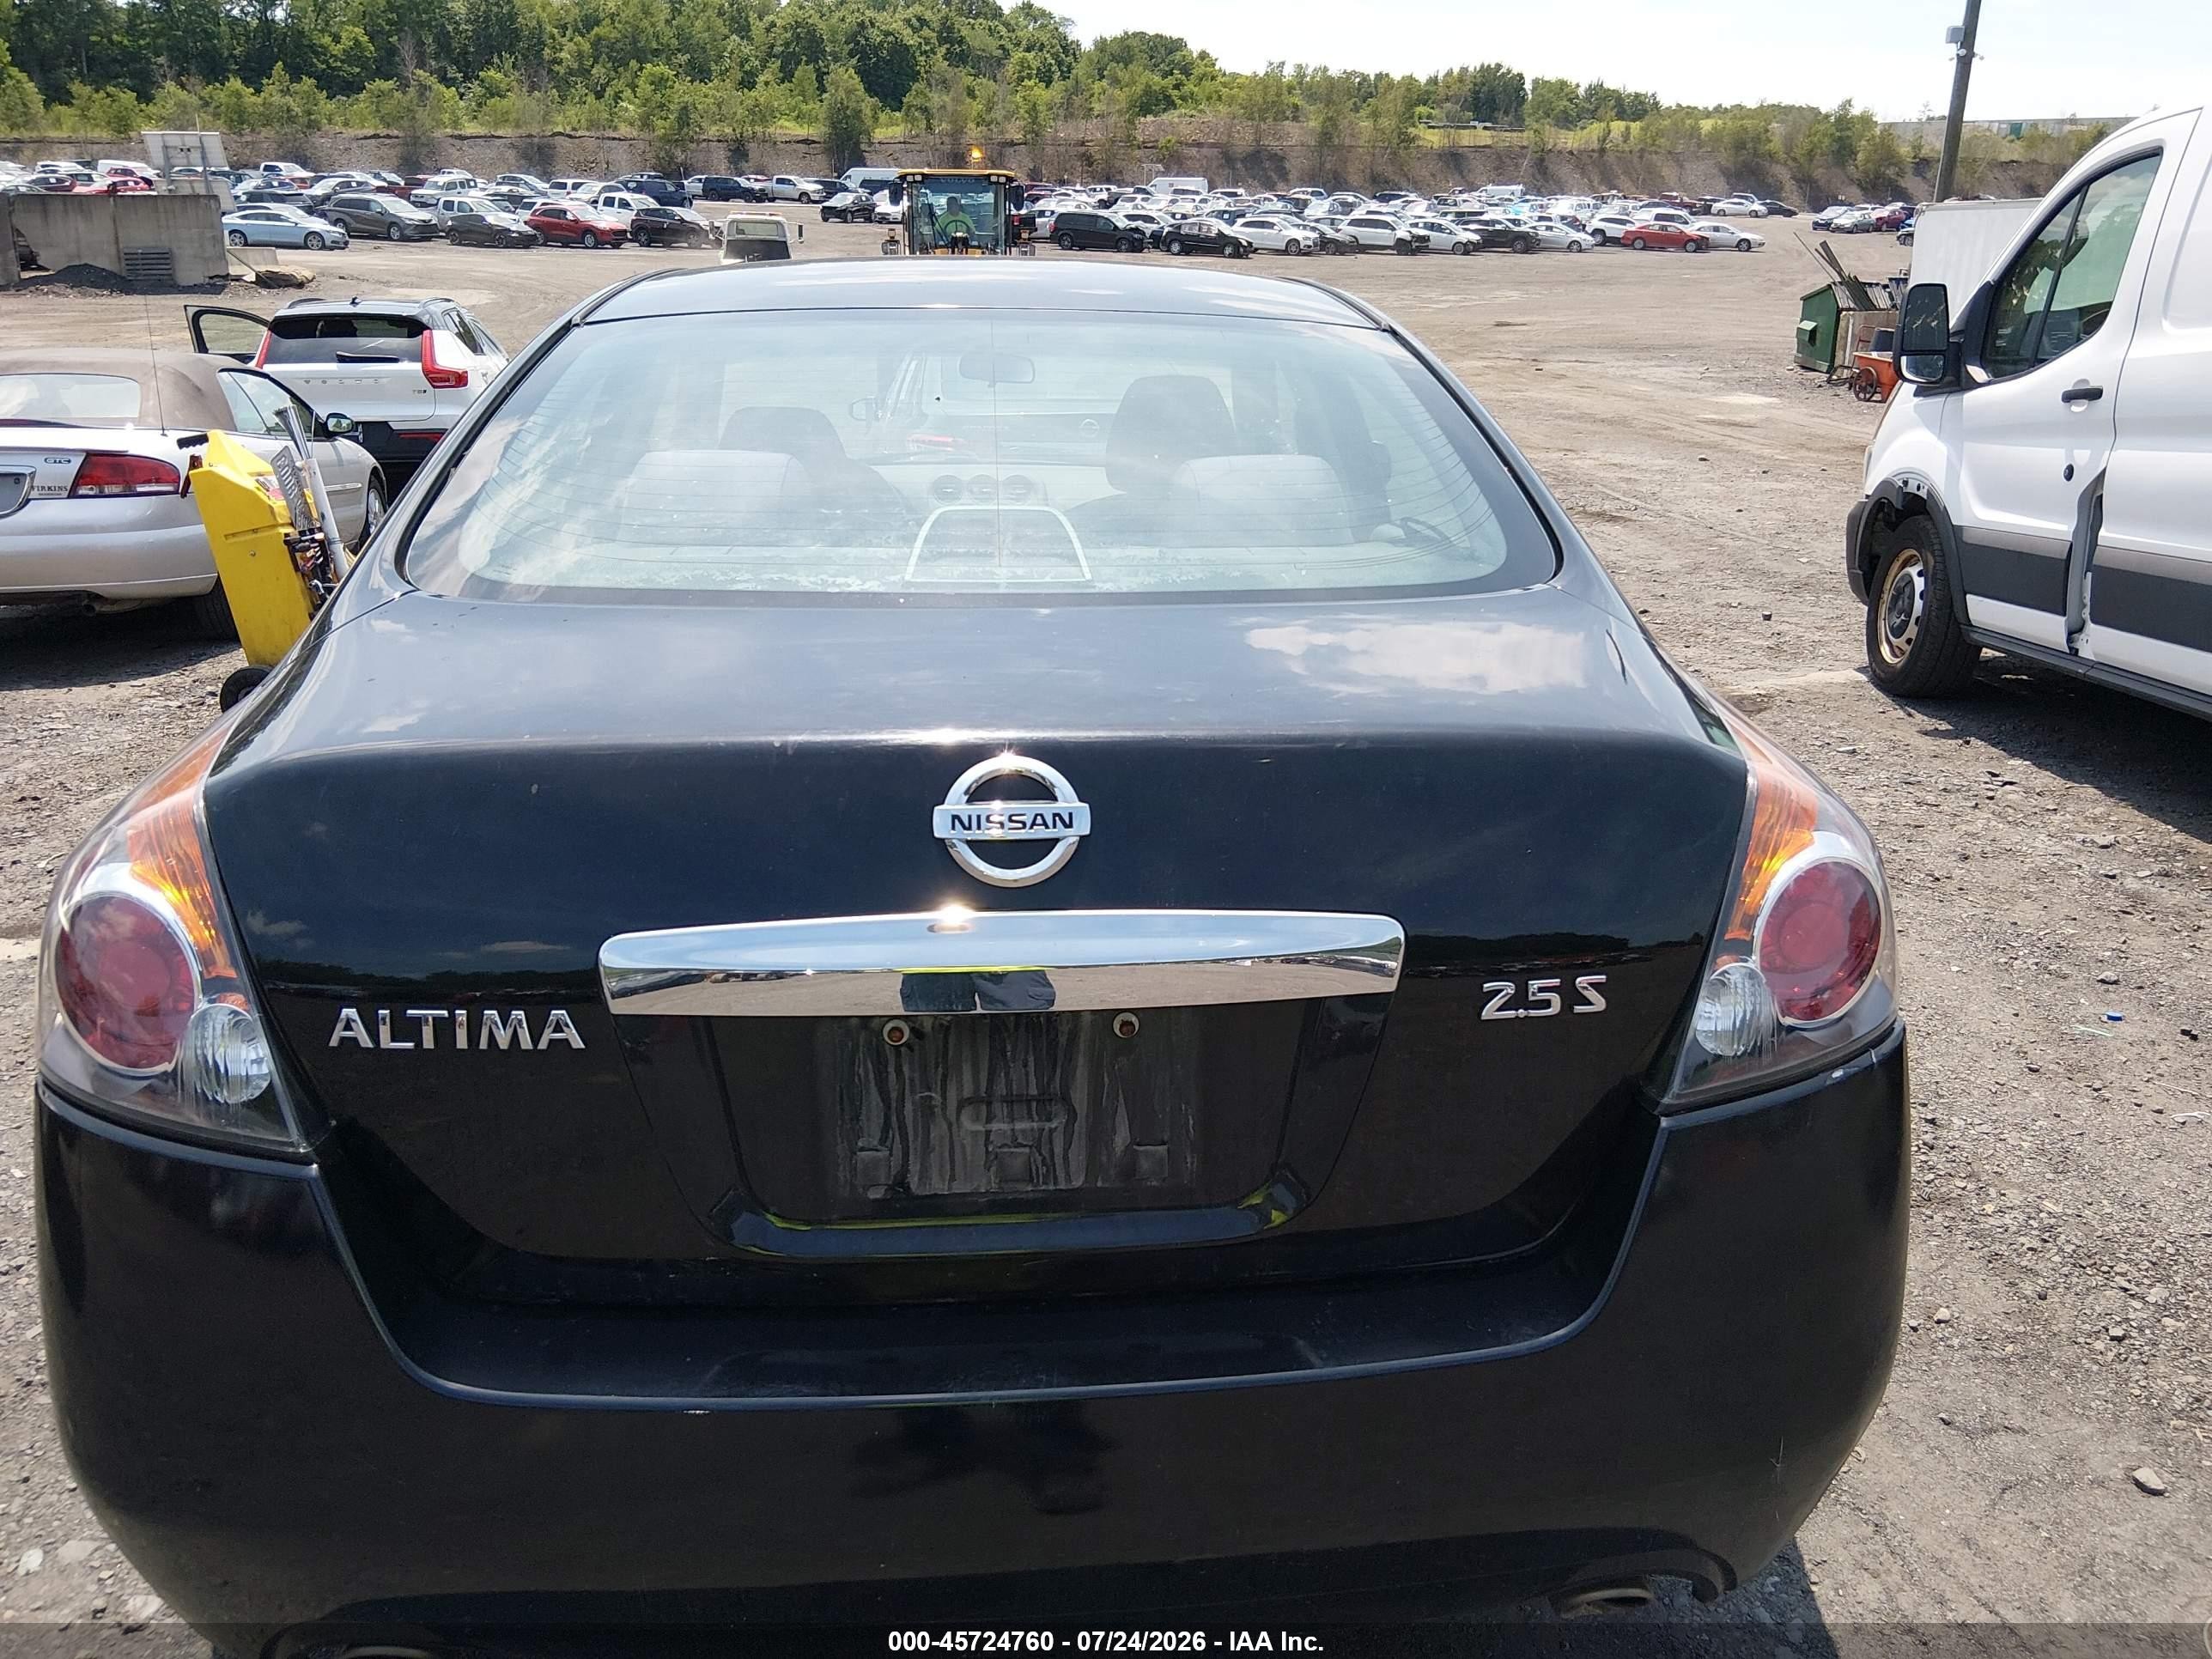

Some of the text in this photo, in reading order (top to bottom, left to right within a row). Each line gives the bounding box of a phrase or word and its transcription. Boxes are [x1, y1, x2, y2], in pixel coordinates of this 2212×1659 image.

[951, 811, 1073, 832] NISSAN
[1481, 975, 1607, 1020] 2.5 S
[329, 1008, 586, 1049] ALTIMA
